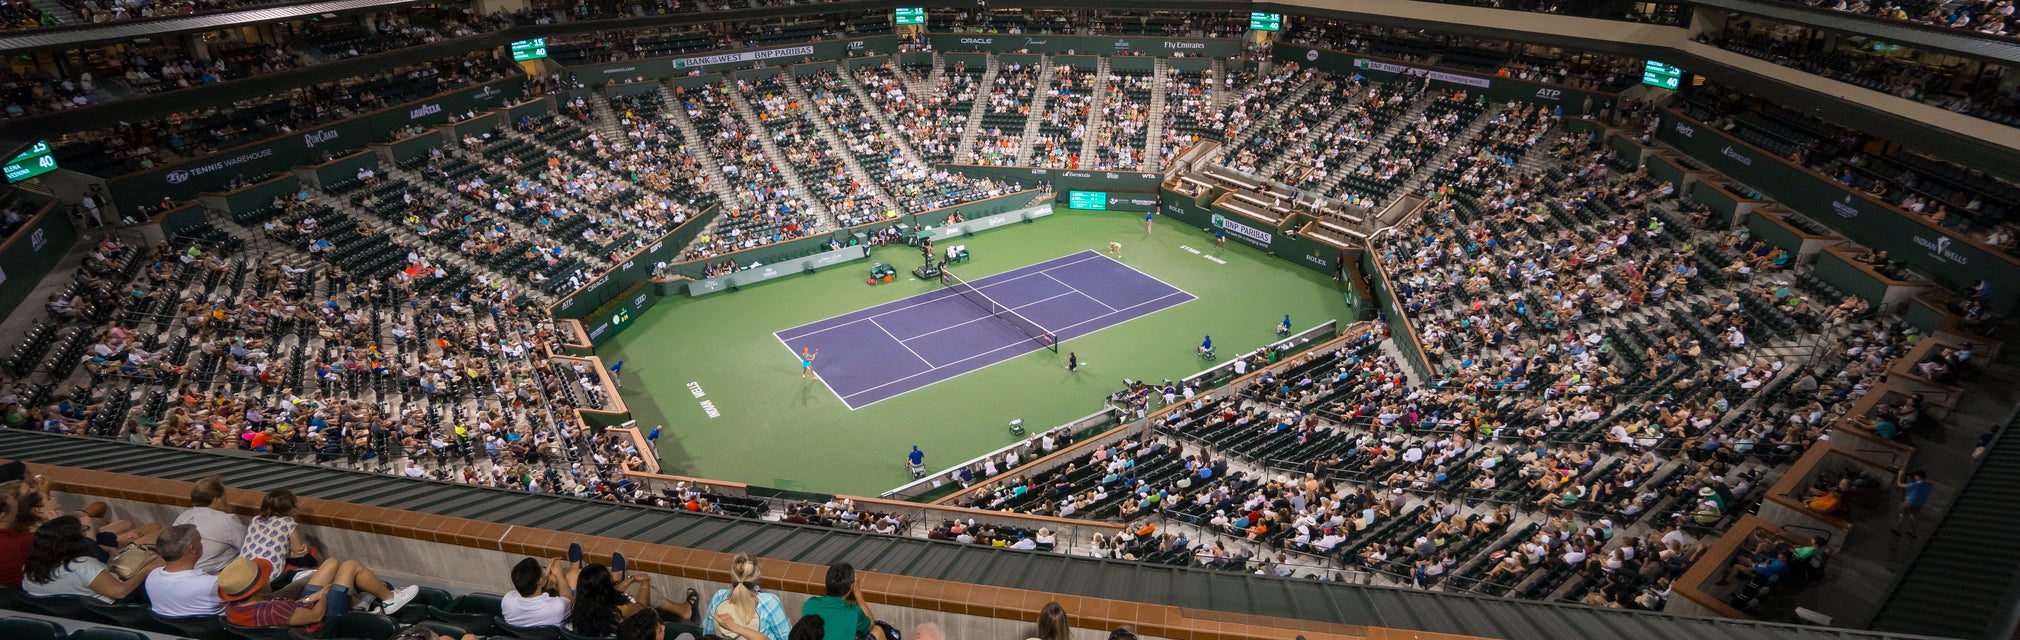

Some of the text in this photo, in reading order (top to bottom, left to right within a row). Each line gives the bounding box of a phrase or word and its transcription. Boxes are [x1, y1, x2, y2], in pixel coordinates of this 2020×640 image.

[914, 7, 923, 15] 15
[1270, 13, 1279, 21] 15
[533, 38, 544, 47] 15
[1164, 41, 1205, 49] Fly Emirates
[536, 48, 546, 56] 40
[686, 56, 711, 67] BANK
[718, 53, 743, 63] WEST
[754, 51, 773, 59] BNP
[774, 46, 812, 57] PARIBAS
[1383, 65, 1406, 74] PARIBA
[1666, 77, 1678, 87] 40
[1535, 87, 1562, 97] ATP
[1675, 121, 1694, 138] Hertz
[189, 162, 223, 176] TENNIS
[224, 148, 273, 167] WAREHOUSE
[1727, 148, 1752, 166] Barracuda
[3, 155, 54, 173] ELENA 40
[1168, 204, 1185, 215] ROLEX
[1224, 219, 1269, 242] BNP PARIBAS
[31, 227, 44, 248] ATP
[1912, 235, 1938, 251] INDIAN
[1944, 249, 1968, 265] WELLS
[622, 260, 634, 271] FILA
[1305, 254, 1327, 266] ROLEX
[587, 275, 610, 292] ORACLE
[562, 298, 573, 309] ATP
[686, 381, 706, 399] WELLS
